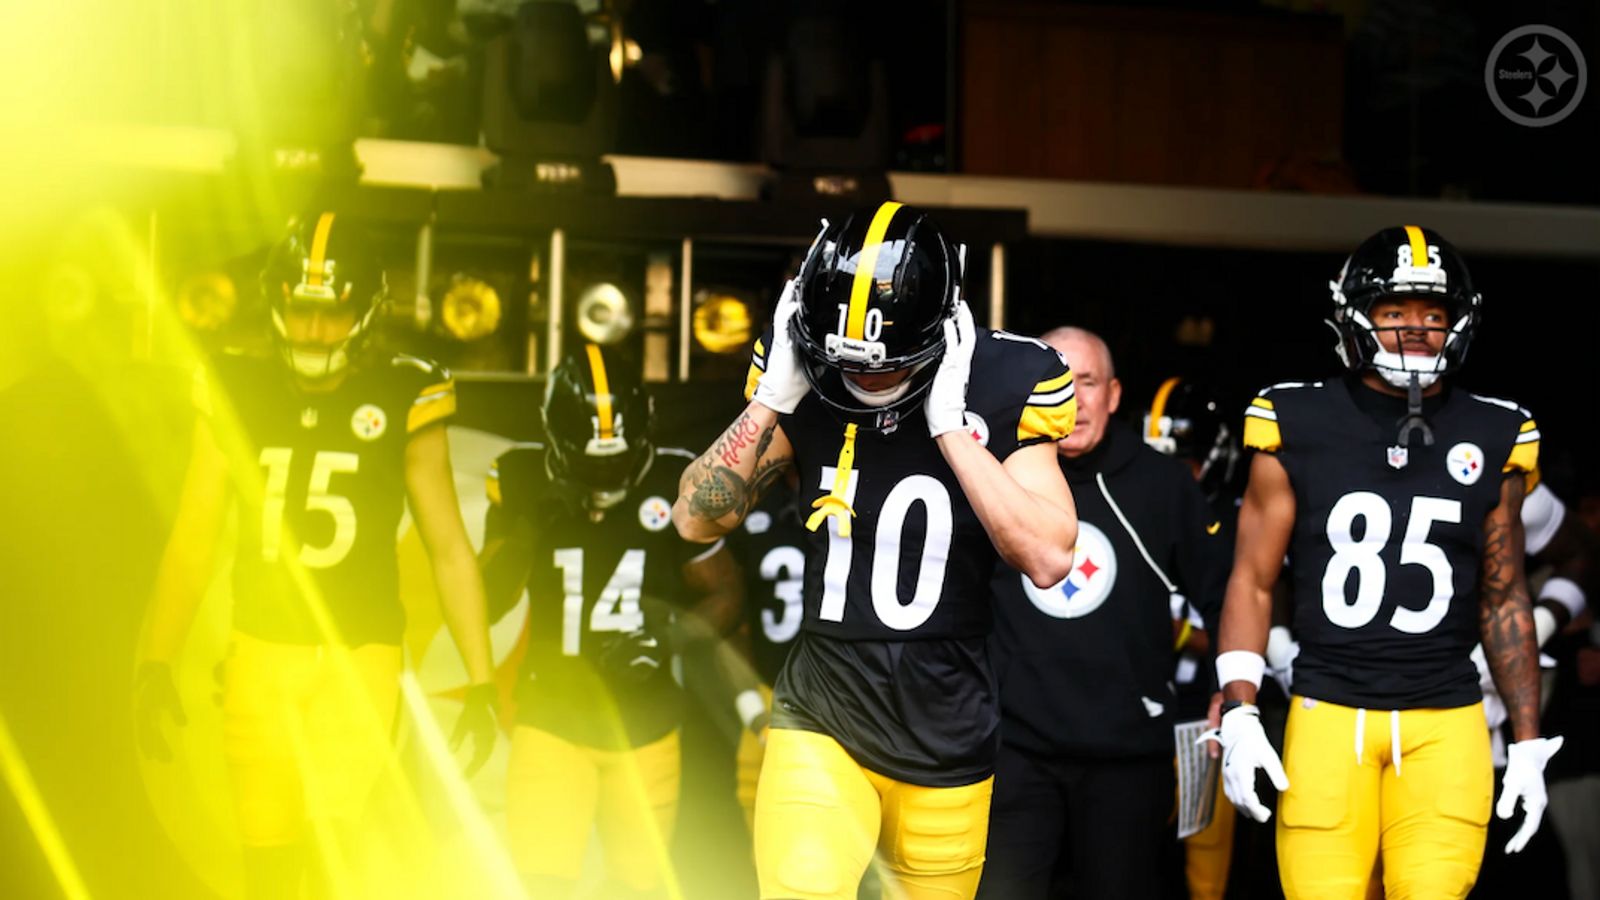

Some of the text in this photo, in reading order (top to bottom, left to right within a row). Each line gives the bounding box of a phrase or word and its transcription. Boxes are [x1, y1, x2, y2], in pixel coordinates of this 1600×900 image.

[1397, 243, 1441, 269] 85
[837, 302, 883, 342] 10
[258, 447, 360, 569] 15
[819, 465, 953, 631] 10
[1322, 491, 1462, 634] 85
[553, 547, 646, 656] 14
